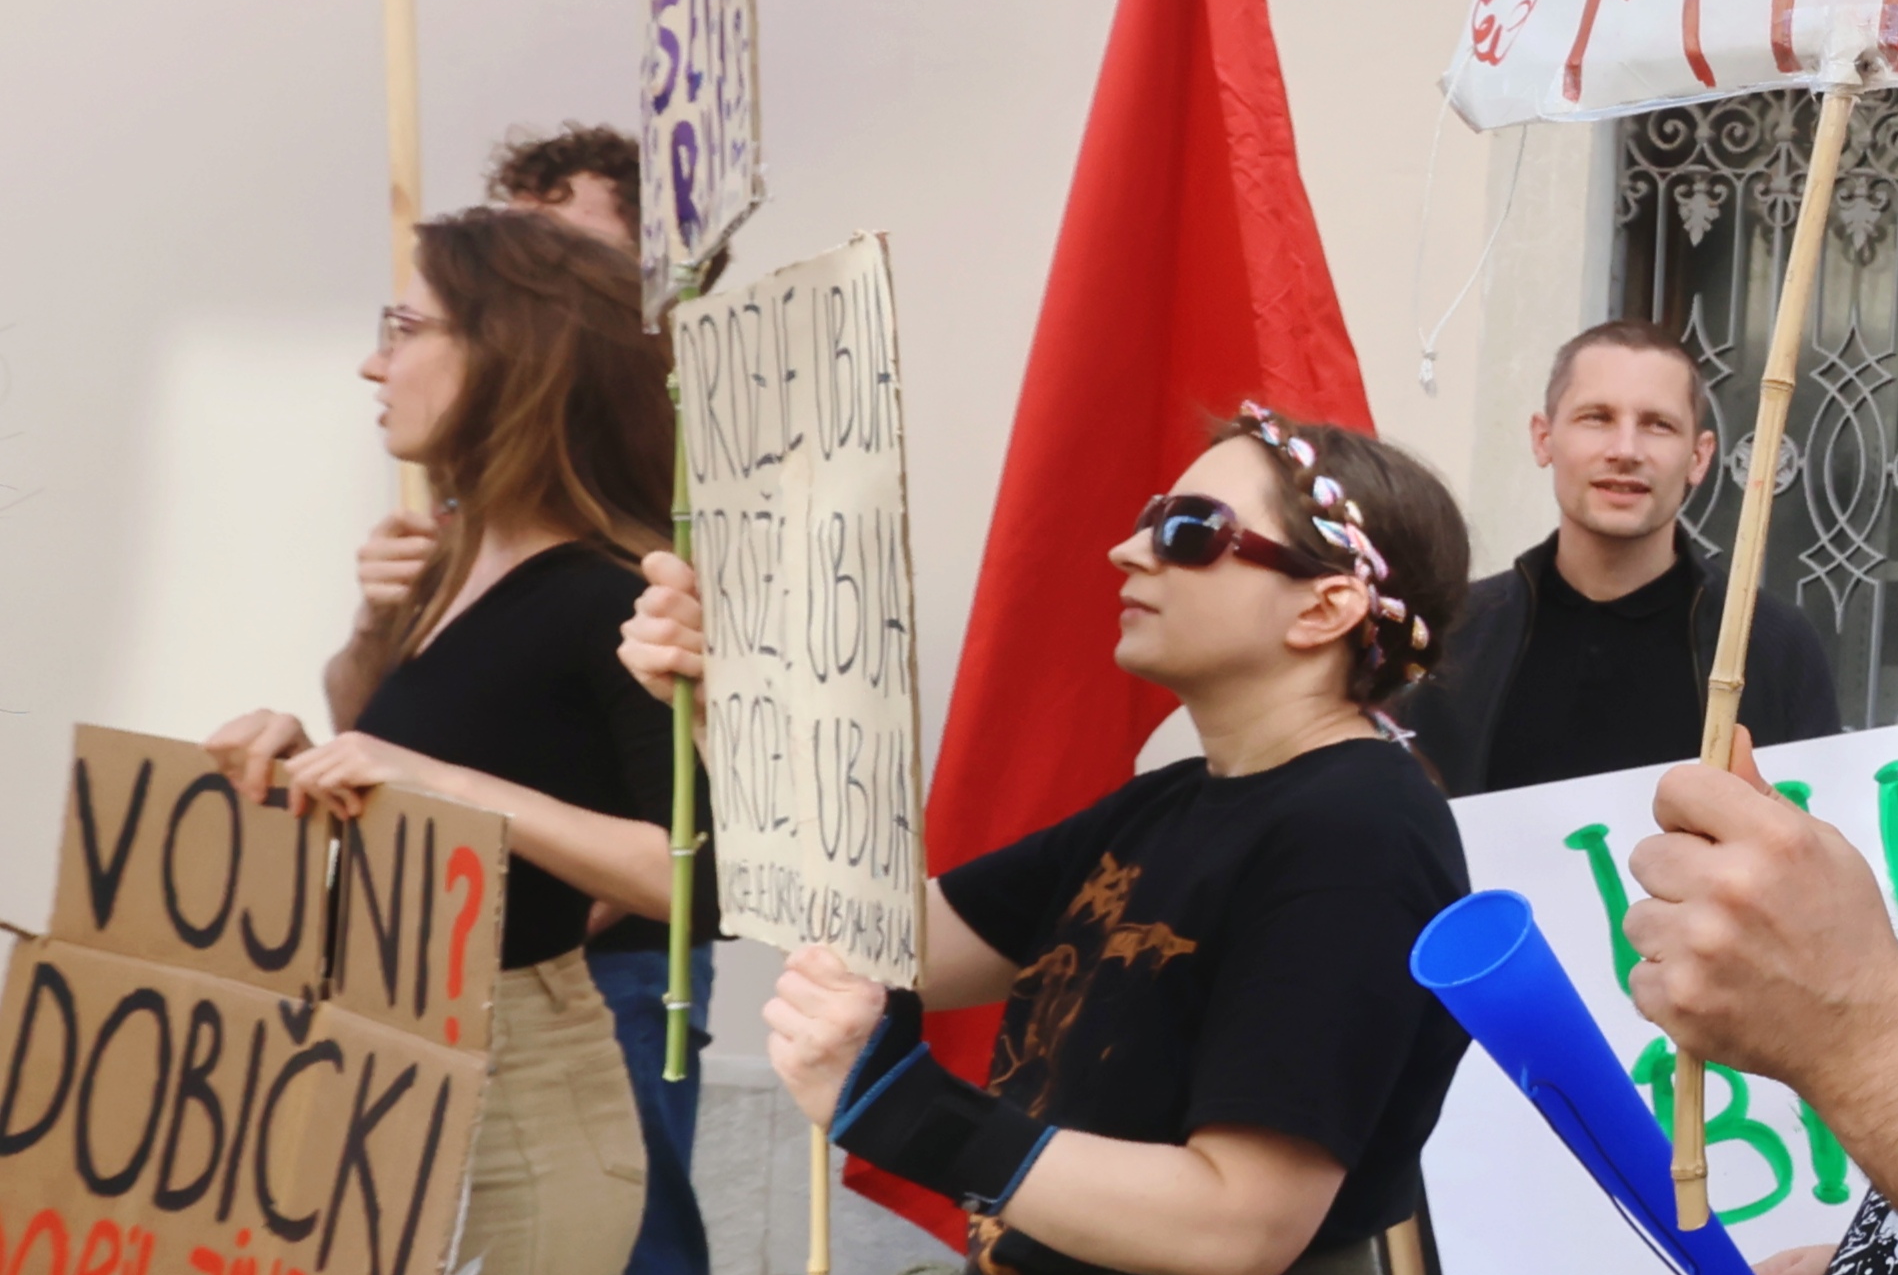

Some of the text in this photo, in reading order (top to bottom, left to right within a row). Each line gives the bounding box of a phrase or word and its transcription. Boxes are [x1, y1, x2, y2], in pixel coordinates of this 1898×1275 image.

[806, 506, 907, 699] UBIJA
[75, 756, 485, 1044] VOJNI?
[812, 717, 911, 895] UBIJA
